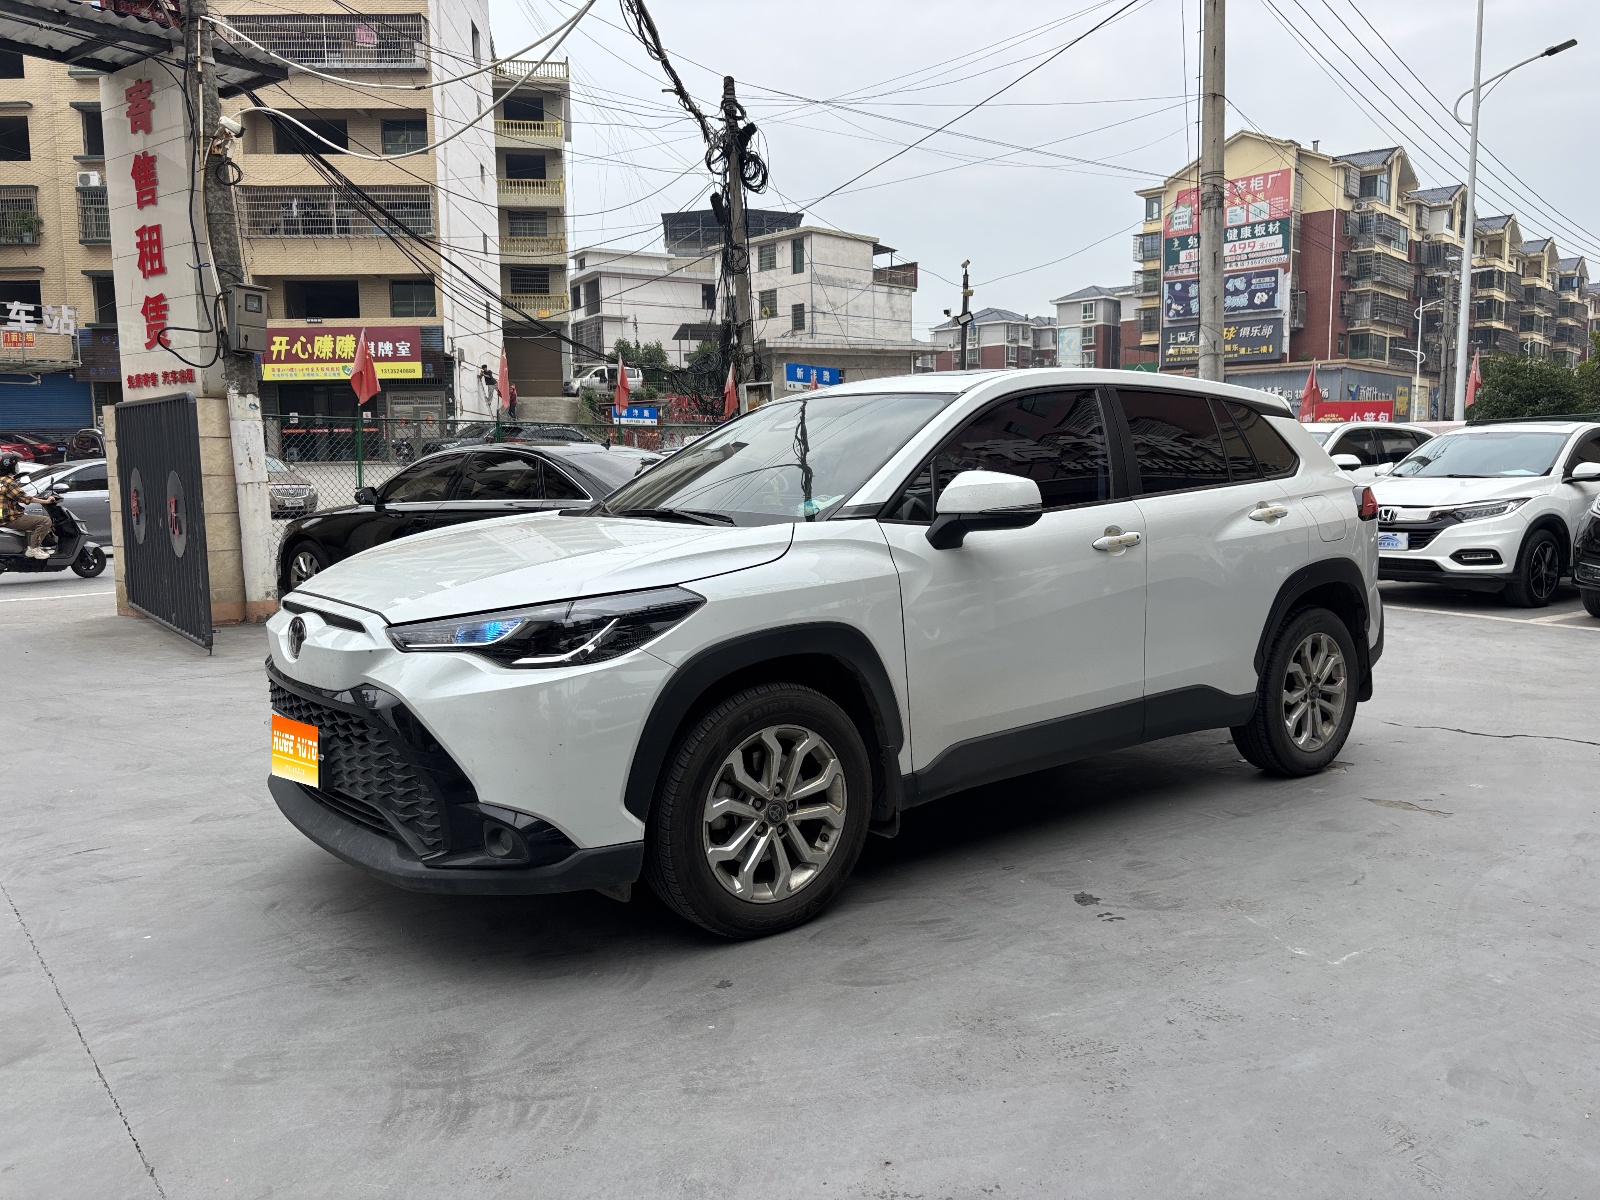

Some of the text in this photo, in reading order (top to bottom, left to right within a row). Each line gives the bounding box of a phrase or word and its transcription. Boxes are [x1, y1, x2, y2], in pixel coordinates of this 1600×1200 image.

[125, 79, 171, 350] 寄售租赁
[1227, 221, 1281, 241] 健康板材
[1228, 241, 1256, 255] 499
[6, 301, 76, 335] 车站
[1239, 324, 1273, 338] 俱乐部
[270, 334, 356, 360] 开心赚赚
